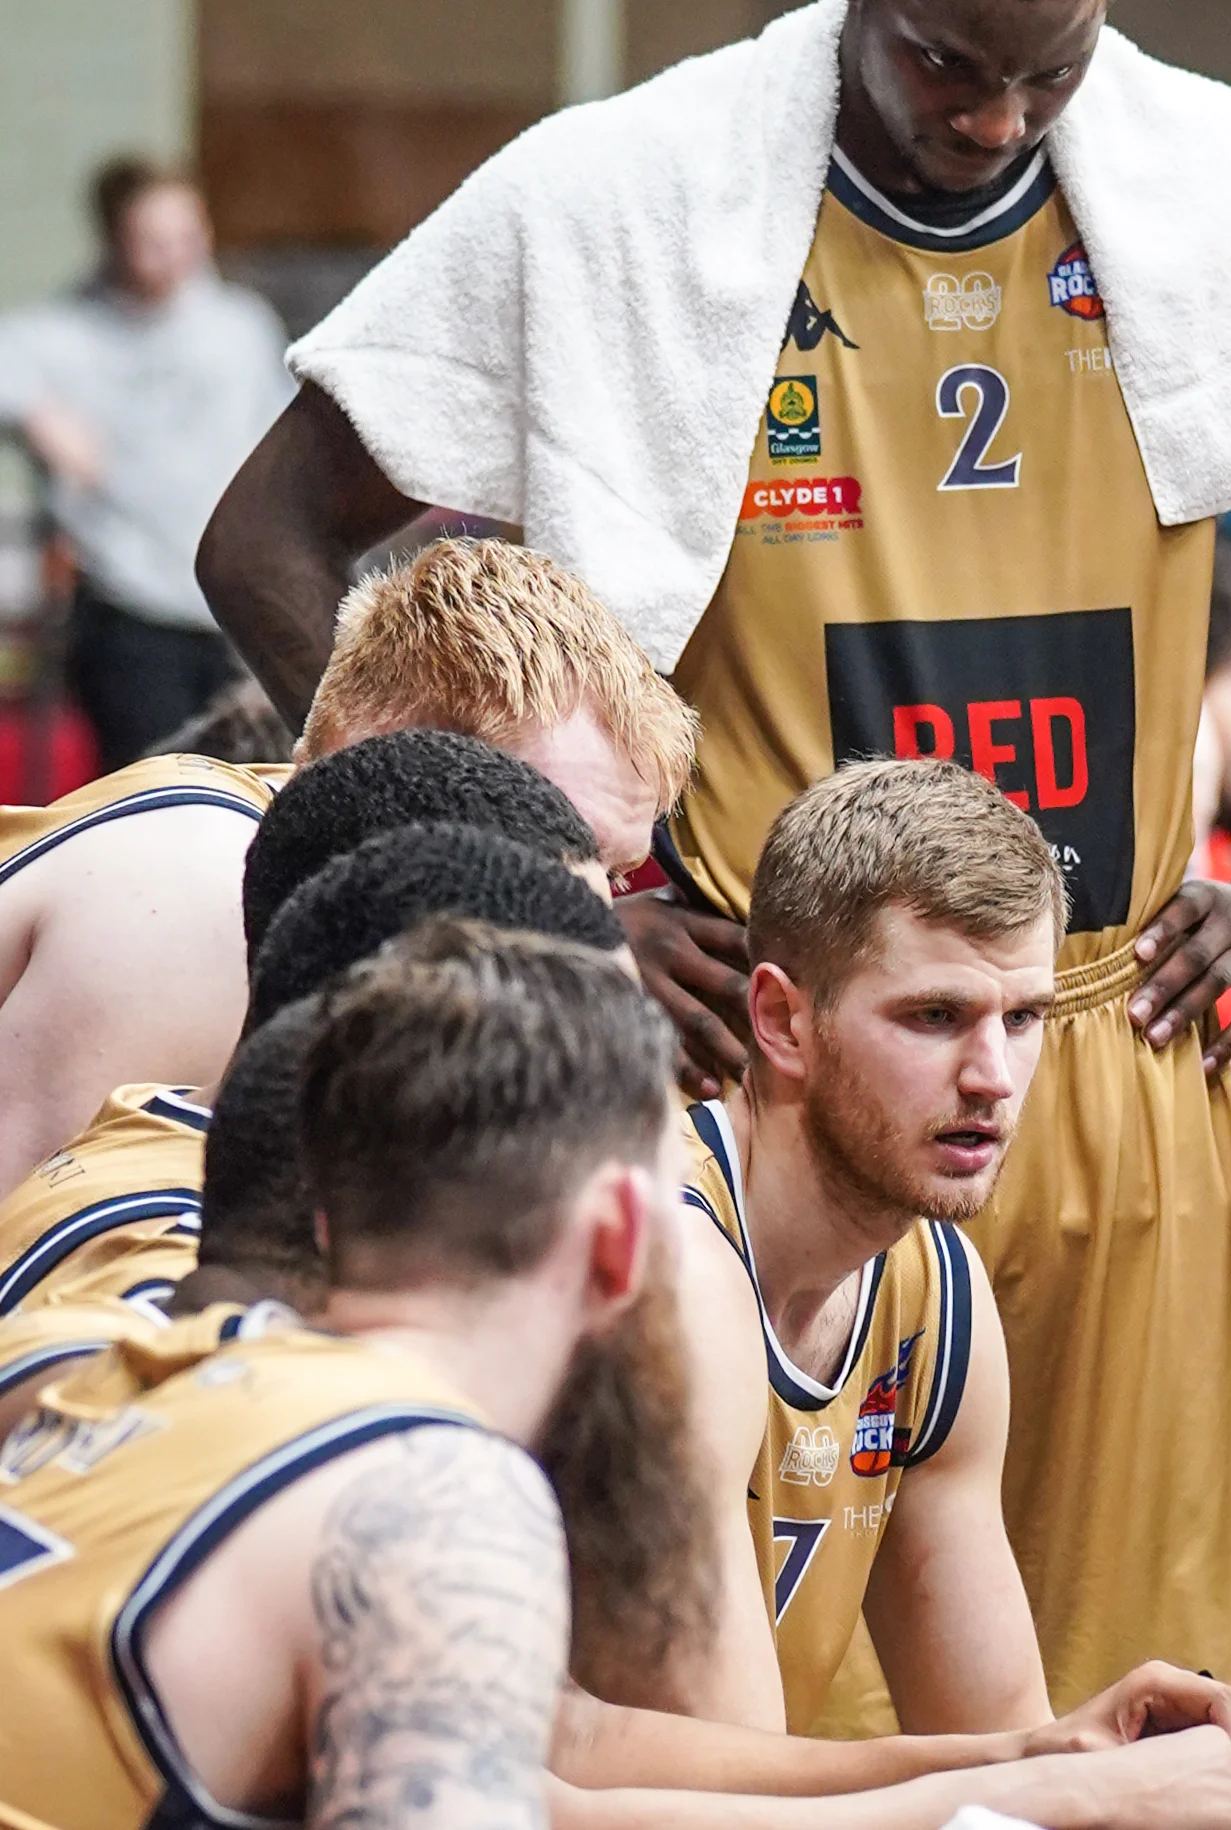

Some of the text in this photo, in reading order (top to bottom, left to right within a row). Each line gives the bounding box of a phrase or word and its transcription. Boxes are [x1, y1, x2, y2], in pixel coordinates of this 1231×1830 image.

[935, 363, 1023, 491] 2
[754, 486, 843, 508] CLYDE 1
[893, 697, 1090, 812] RED
[786, 1449, 838, 1471] ROCKS
[772, 1516, 832, 1628] 7
